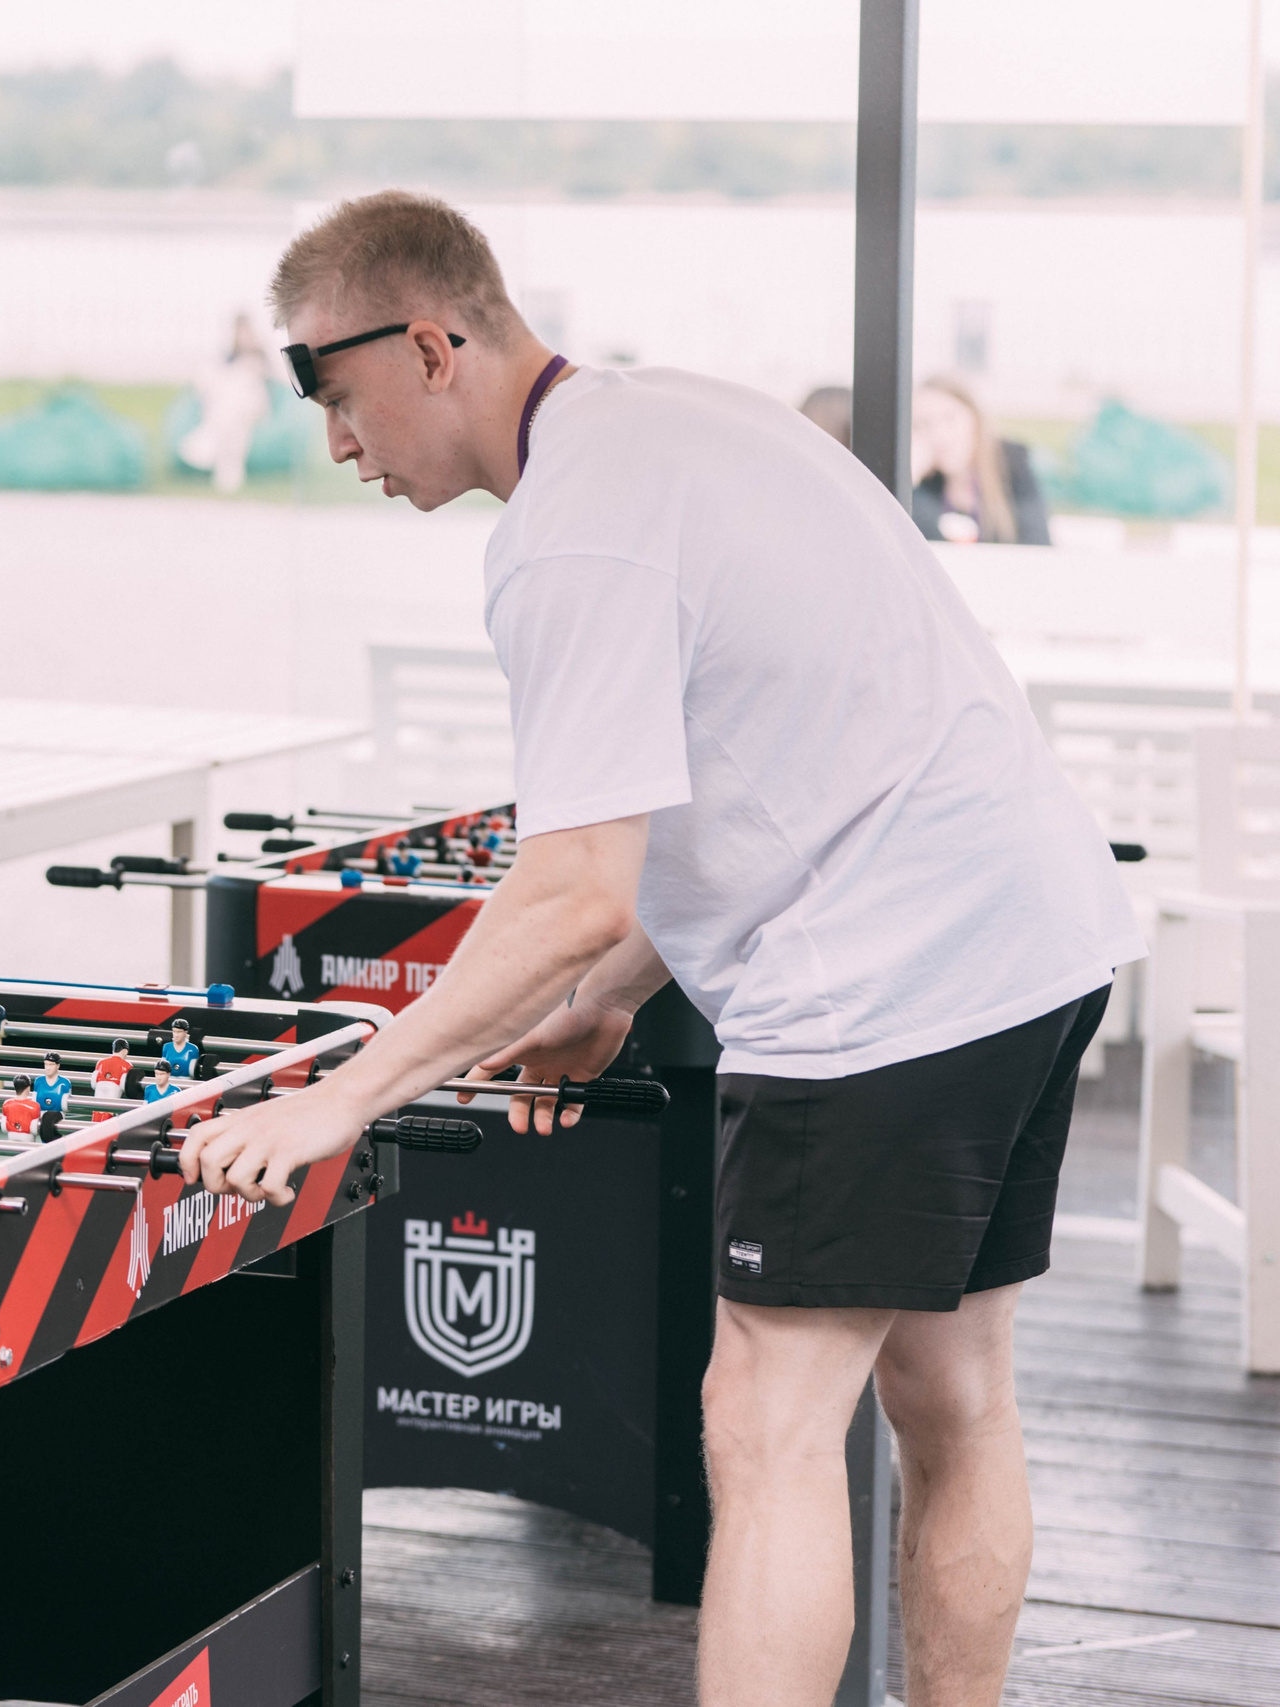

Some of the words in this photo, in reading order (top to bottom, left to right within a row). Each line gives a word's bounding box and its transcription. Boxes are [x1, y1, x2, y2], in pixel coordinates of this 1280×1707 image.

[321, 954, 399, 991] АМКАР
[405, 961, 445, 993] ПЕ
[163, 1189, 214, 1257] АМКАР
[377, 1386, 480, 1420] МАСТЕР
[485, 1397, 562, 1430] ИГРЫ
